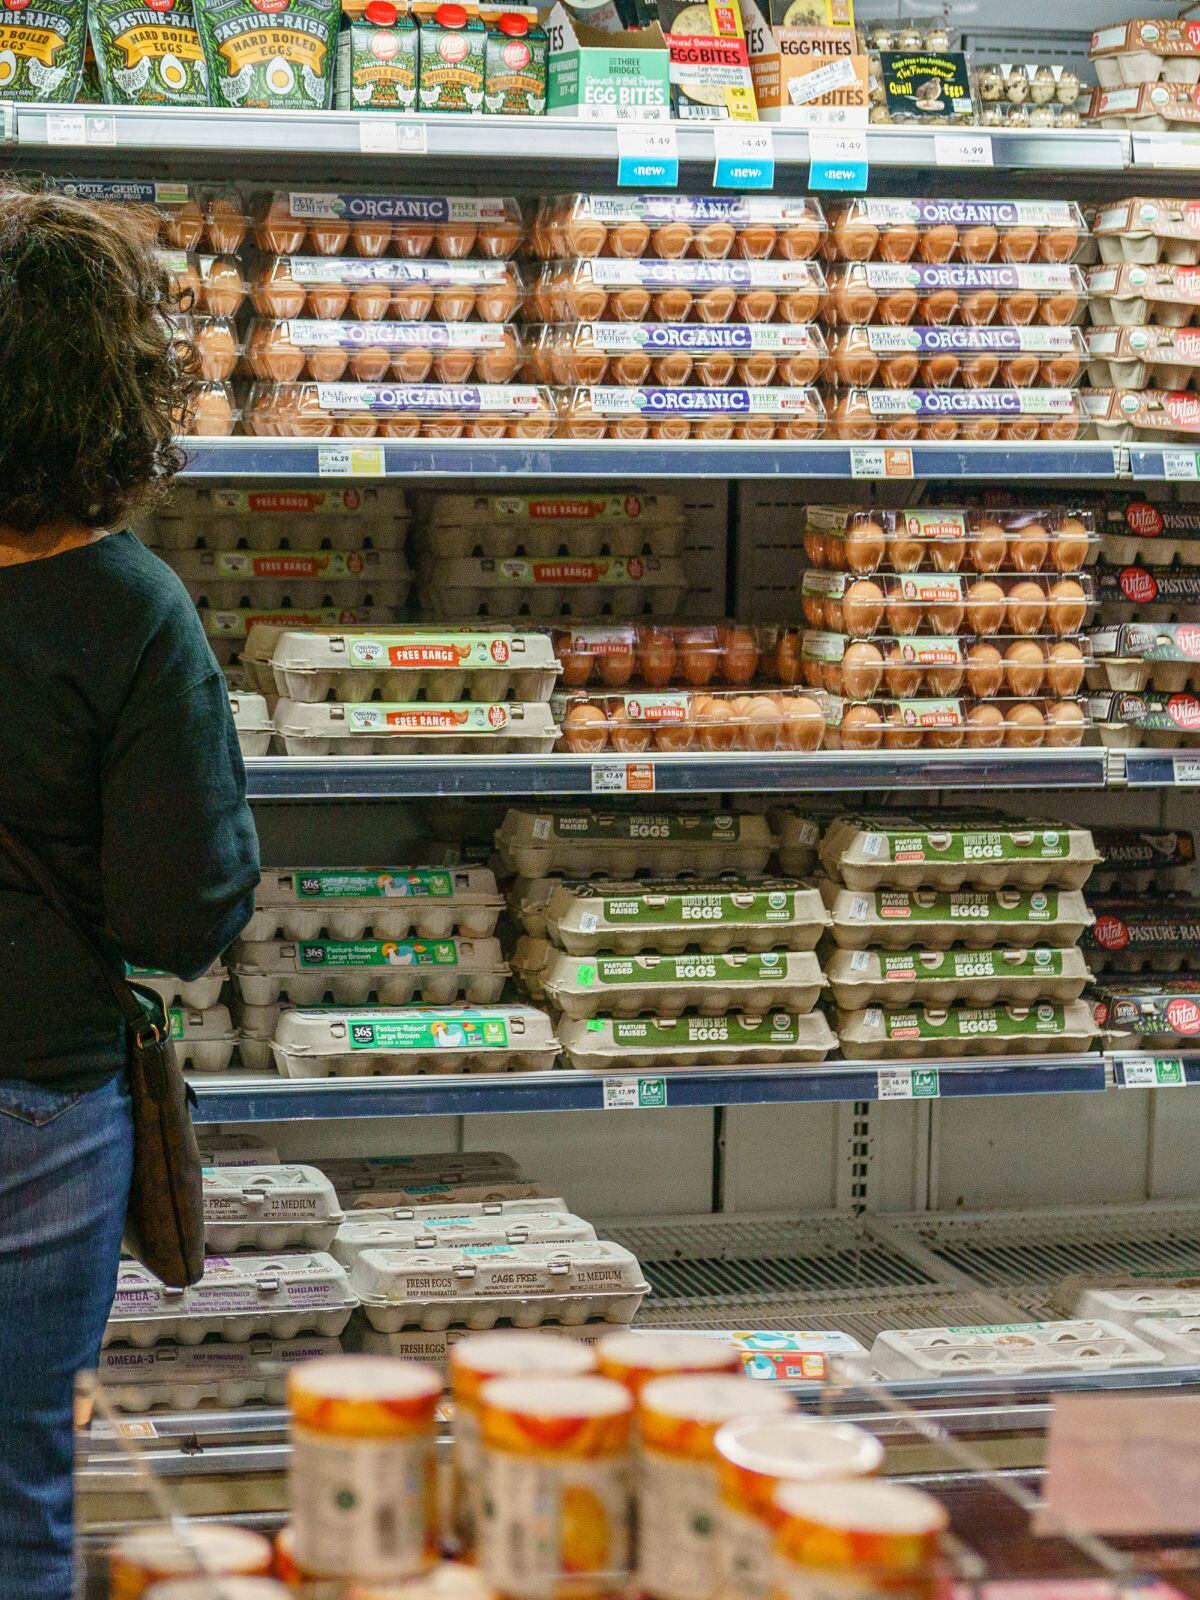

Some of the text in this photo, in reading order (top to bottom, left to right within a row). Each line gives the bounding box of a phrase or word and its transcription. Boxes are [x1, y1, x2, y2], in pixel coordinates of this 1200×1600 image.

[9, 30, 49, 44] BOILED
[130, 31, 201, 46] HARD BOILE
[233, 33, 316, 52] HARD BOILED
[153, 43, 182, 53] EGGS
[260, 46, 292, 56] EGGS
[781, 41, 850, 55] EGG BITES
[670, 47, 740, 64] EGG BITES
[618, 58, 640, 66] THREE
[609, 66, 640, 75] BRIDGES
[584, 87, 664, 105] EGG BITES
[637, 166, 661, 177] new
[734, 168, 758, 179] new
[828, 170, 852, 180] new
[77, 185, 104, 193] PETE
[350, 200, 443, 217] ORGANIC
[924, 205, 1012, 221] ORGANIC
[653, 329, 746, 346] ORGANIC
[926, 331, 1015, 347] ORGANIC
[379, 389, 475, 406] ORGANIC
[650, 392, 744, 408] ORGANIC
[752, 394, 778, 402] FREE
[925, 395, 1015, 410] ORGANIC
[1128, 507, 1158, 526] Vital
[397, 650, 454, 661] FREE RANGE
[895, 838, 922, 846] PASTURE
[963, 835, 1001, 846] WORLD'S BEST
[964, 845, 1002, 858] EGGS
[682, 896, 721, 906] WORLD'S BEST
[682, 906, 722, 919] EGGS
[354, 1027, 372, 1037] 365
[376, 1025, 426, 1033] Pasture-Raised
[376, 1033, 396, 1041] Large
[272, 1200, 316, 1209] 12 MEDIUM
[491, 1274, 537, 1283] CAGE FREE
[578, 1271, 622, 1281] 12 MEDIUM
[406, 1278, 451, 1288] FRESH EGGS
[288, 1286, 330, 1294] ORGANIC
[108, 1354, 154, 1365] OMEGA-3
